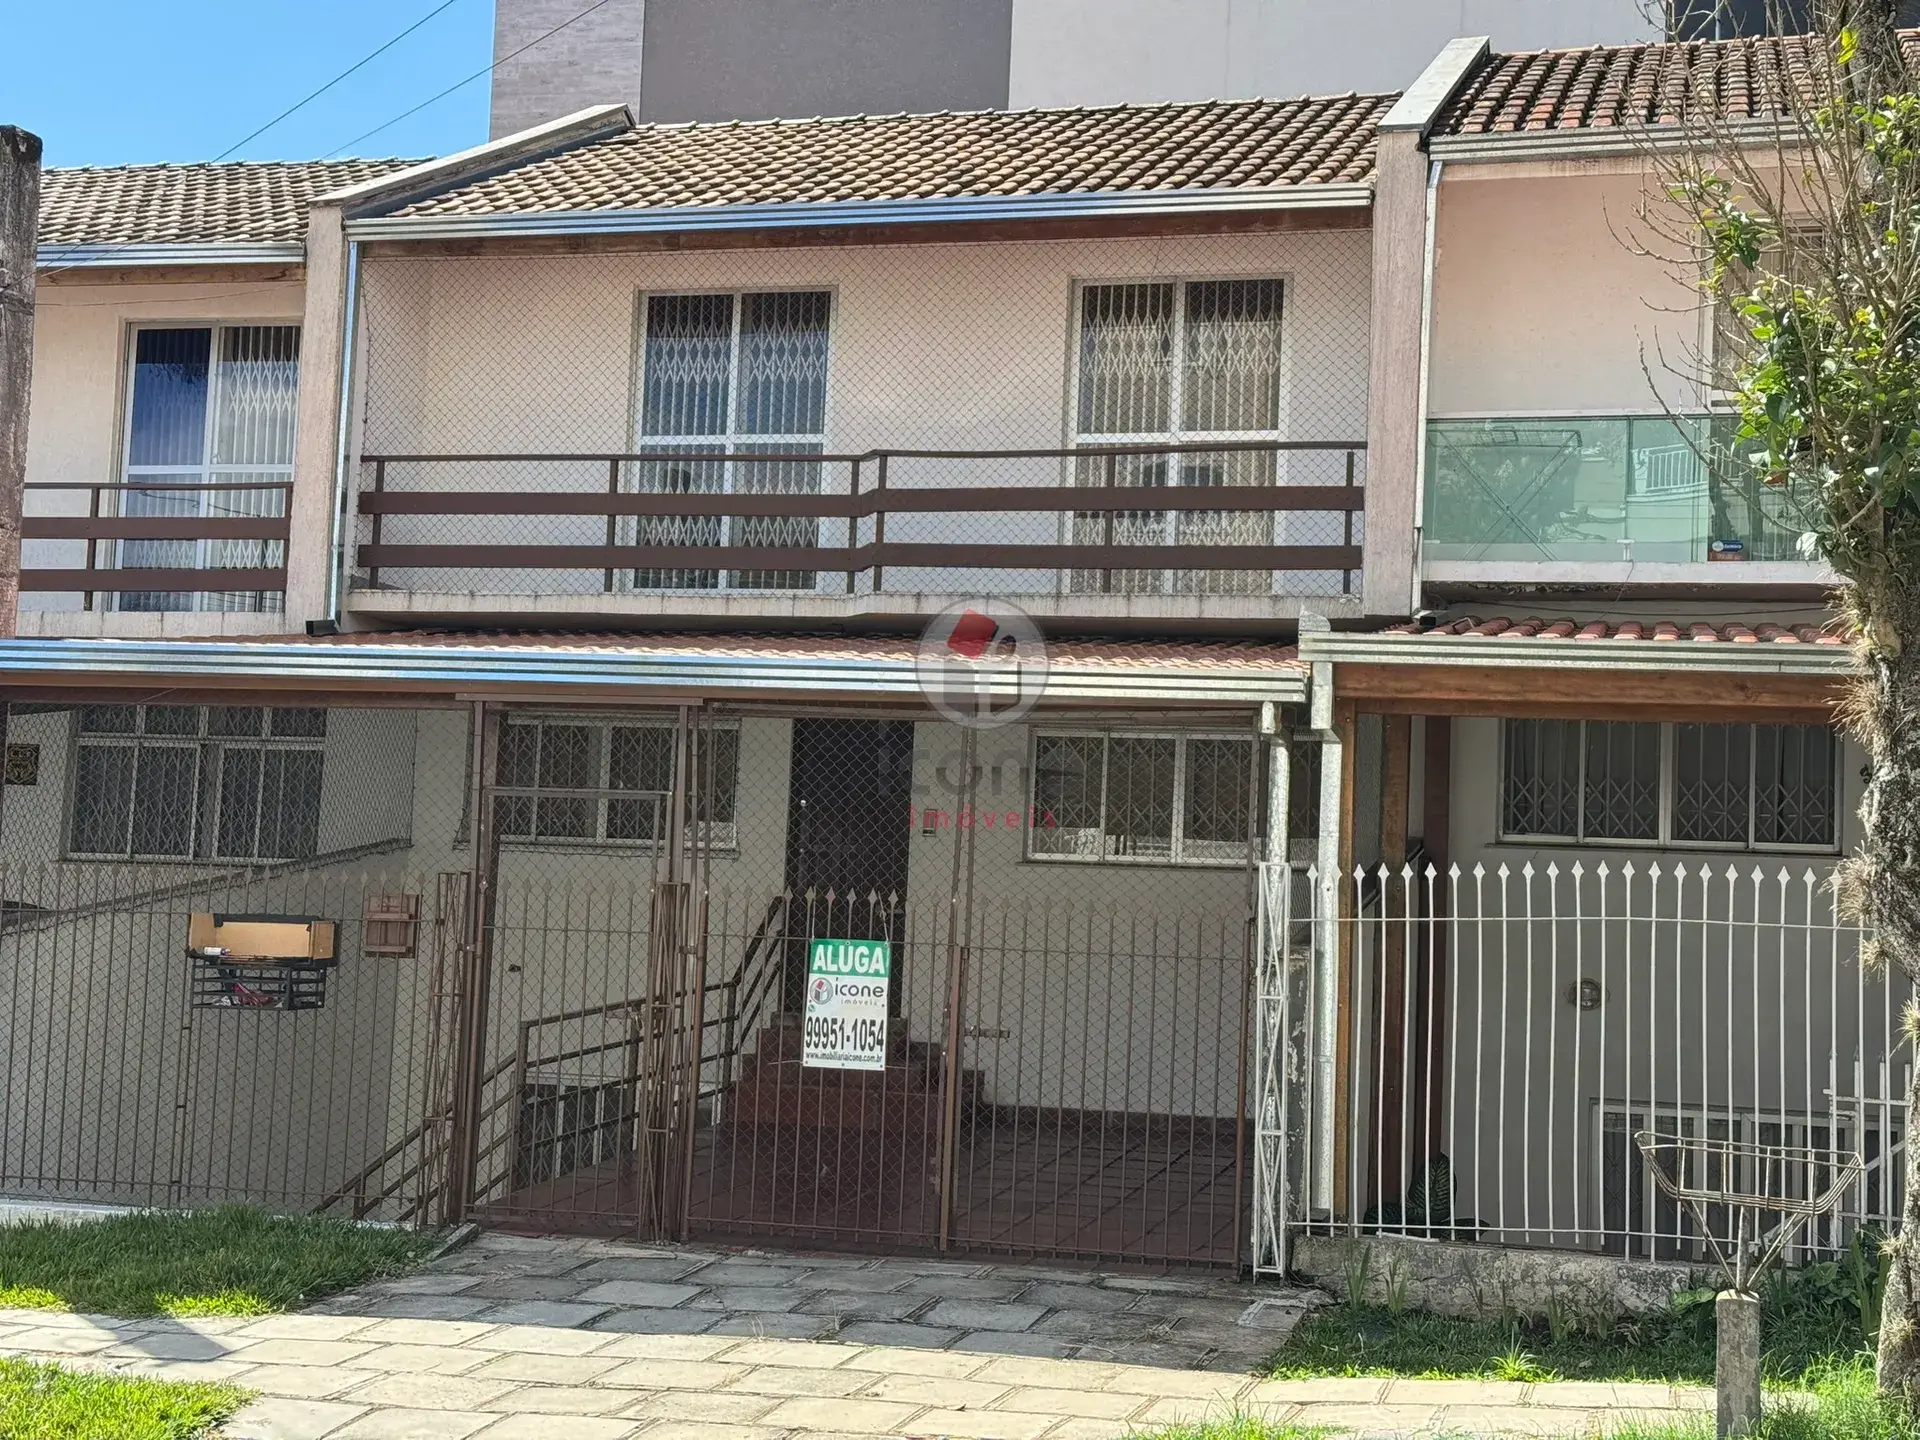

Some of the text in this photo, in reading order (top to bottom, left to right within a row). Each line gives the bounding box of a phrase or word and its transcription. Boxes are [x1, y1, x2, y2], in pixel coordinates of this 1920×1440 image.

[812, 945, 885, 974] ALUGA
[805, 1016, 884, 1052] 99951-1054
[805, 1051, 883, 1062] www.imobiliariaicone.com.br
